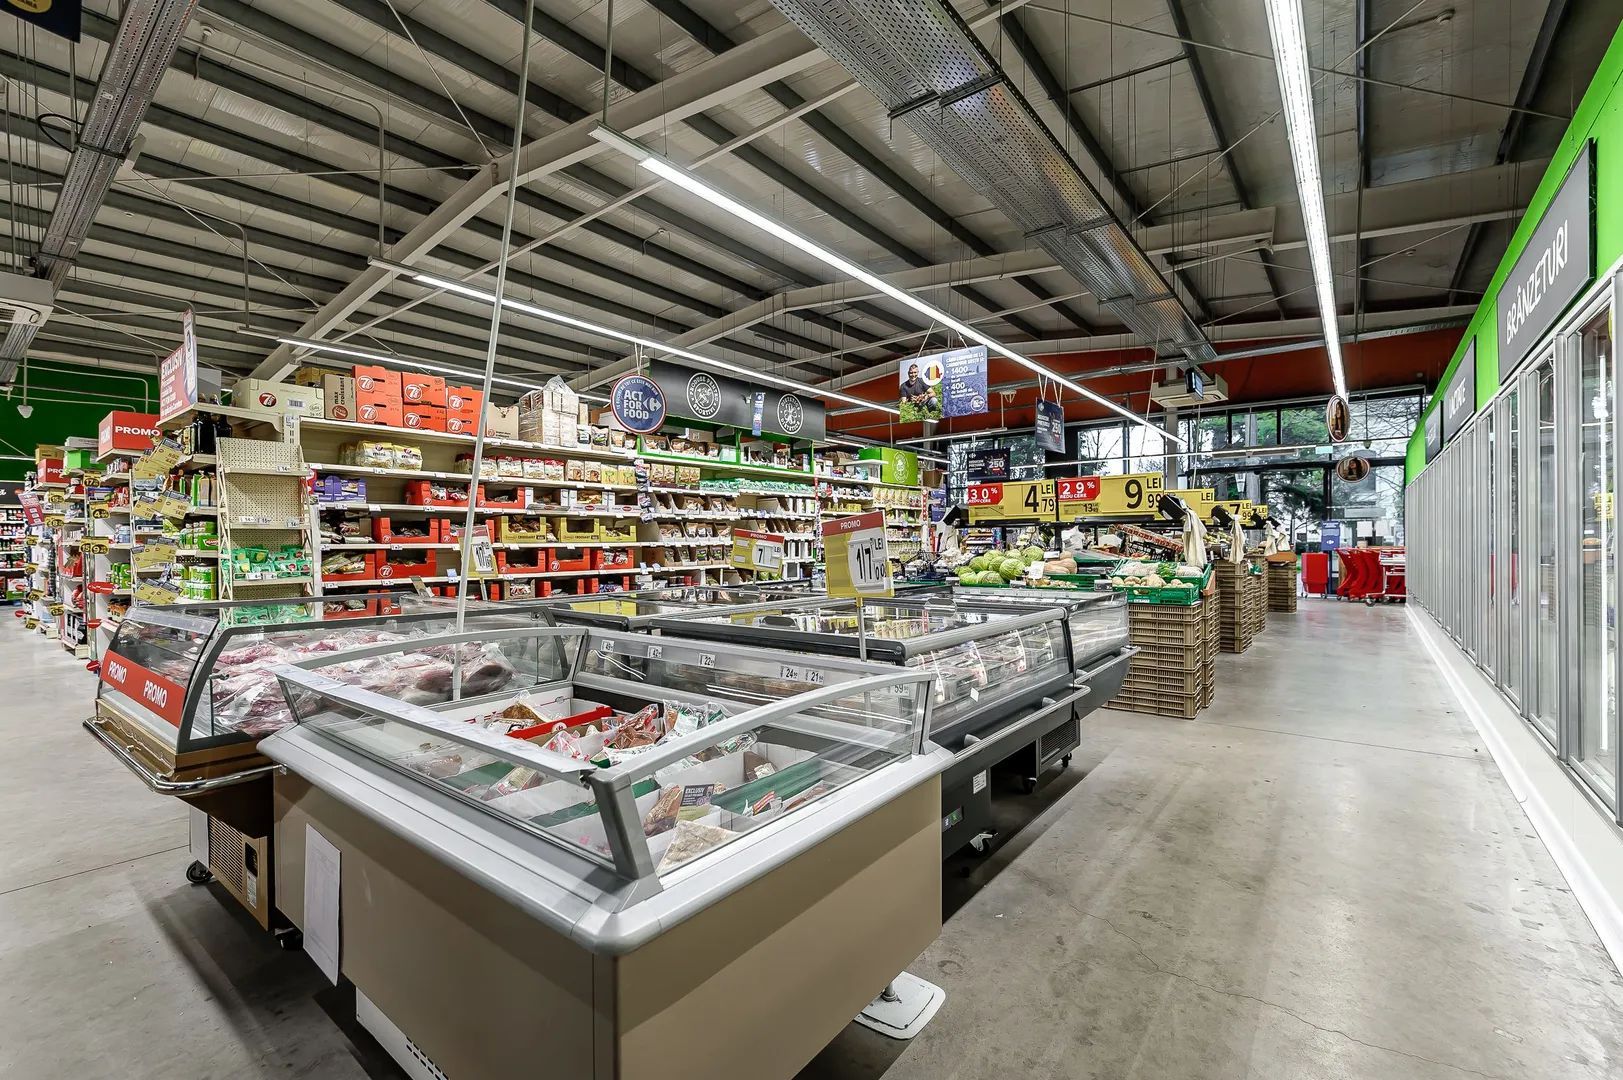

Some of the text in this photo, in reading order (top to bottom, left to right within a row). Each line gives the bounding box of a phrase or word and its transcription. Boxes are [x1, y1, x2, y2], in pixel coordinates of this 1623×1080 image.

[1506, 219, 1568, 345] BRÂNZETURI
[951, 382, 965, 390] 400
[623, 390, 643, 401] ACT
[623, 400, 642, 410] FOR
[623, 409, 649, 420] FOOD
[115, 425, 160, 437] PROMO
[988, 460, 1005, 469] 250
[1041, 483, 1054, 494] LEI
[1146, 477, 1162, 489] LEI
[1024, 485, 1039, 513] 4
[1124, 478, 1143, 509] 9
[1201, 492, 1213, 501] LEI
[1042, 498, 1054, 512] 79
[1147, 493, 1161, 508] 99
[841, 519, 861, 530] PROMO
[750, 532, 767, 540] PROMO
[874, 537, 884, 550] LEI
[758, 548, 763, 563] 7
[107, 660, 128, 685] PROMO
[786, 668, 794, 678] 24
[811, 671, 819, 682] 21
[143, 680, 168, 709] PROMO
